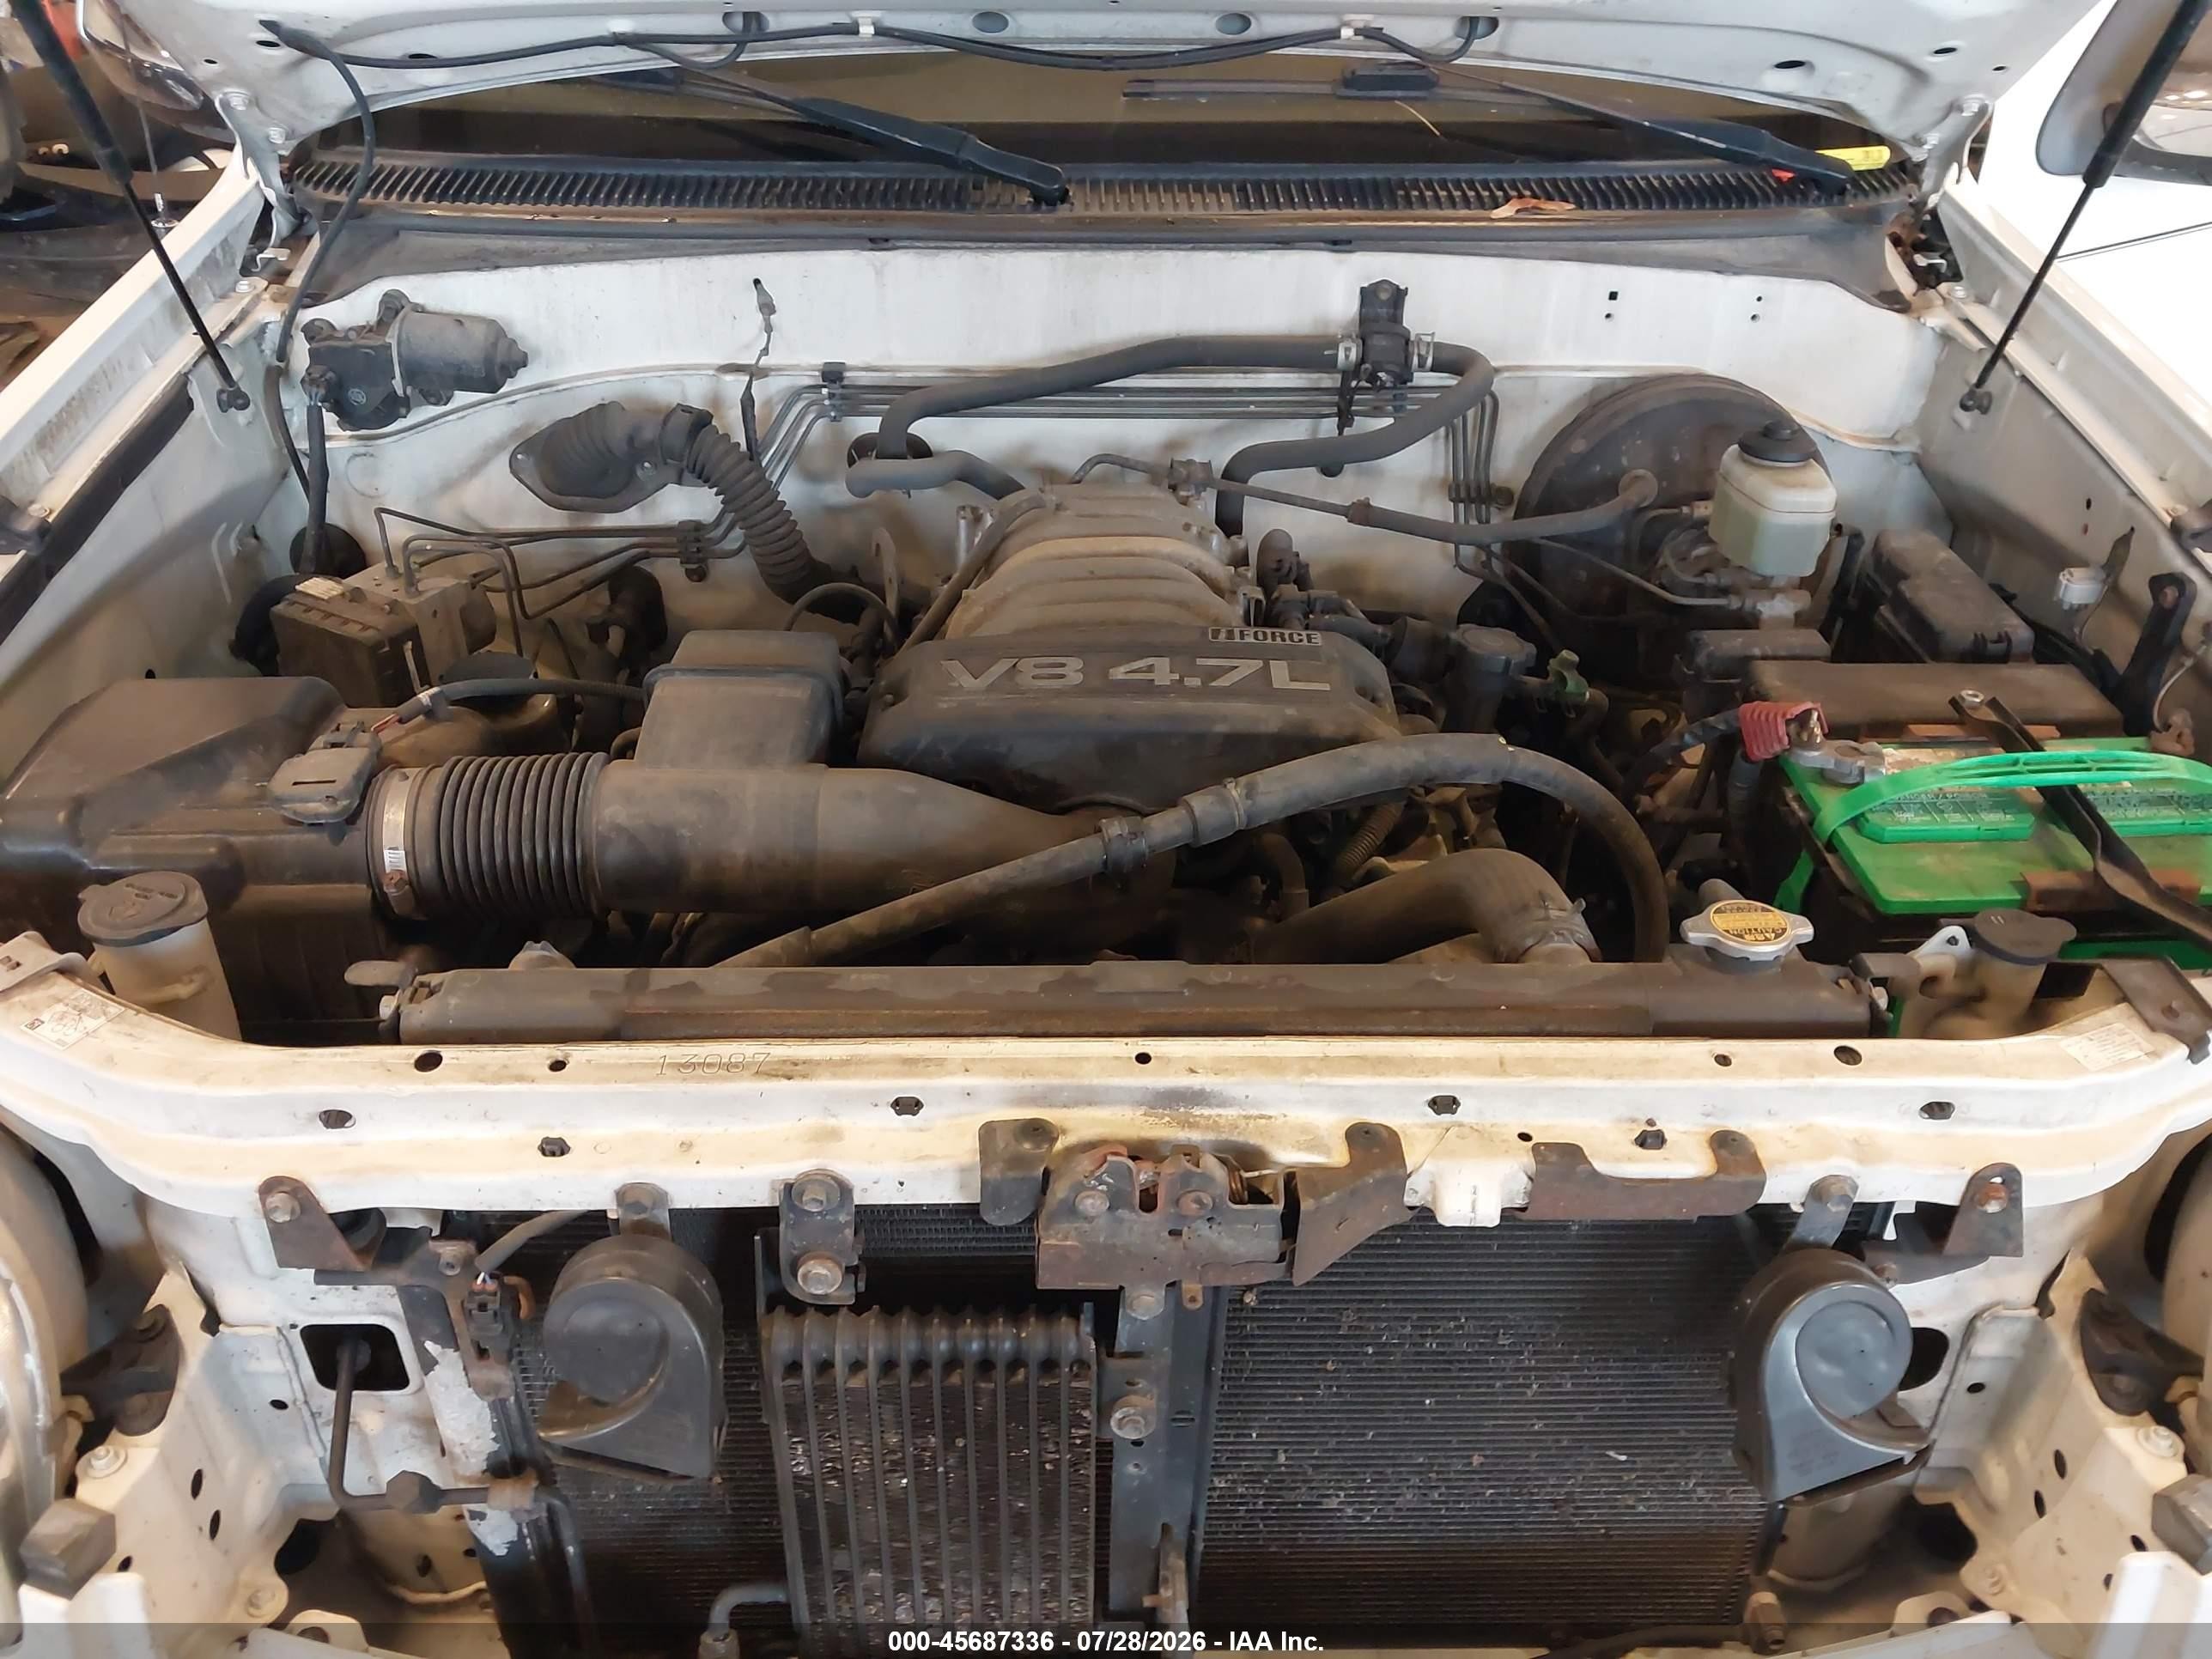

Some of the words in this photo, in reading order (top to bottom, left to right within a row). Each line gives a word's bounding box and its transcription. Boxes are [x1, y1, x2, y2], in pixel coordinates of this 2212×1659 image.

[940, 656, 1084, 689] V8
[1109, 657, 1330, 690] 4.7L
[656, 1052, 771, 1076] 13087
